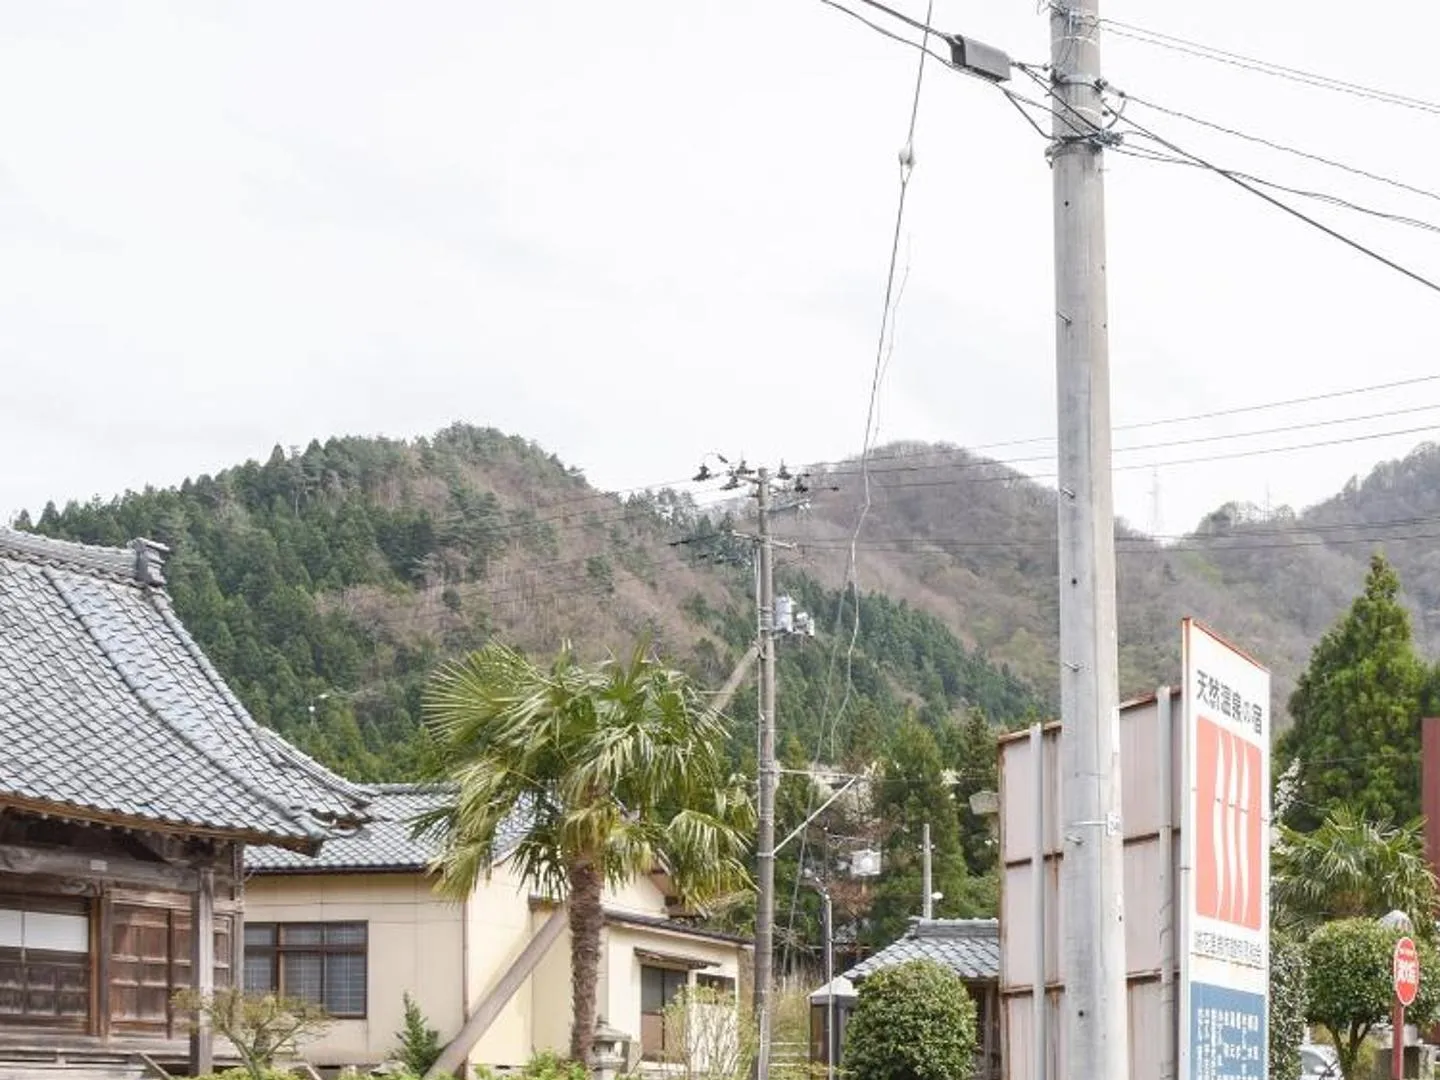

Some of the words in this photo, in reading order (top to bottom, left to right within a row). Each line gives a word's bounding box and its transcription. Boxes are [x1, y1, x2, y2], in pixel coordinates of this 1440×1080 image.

[1197, 668, 1262, 736] 天然温泉の宿
